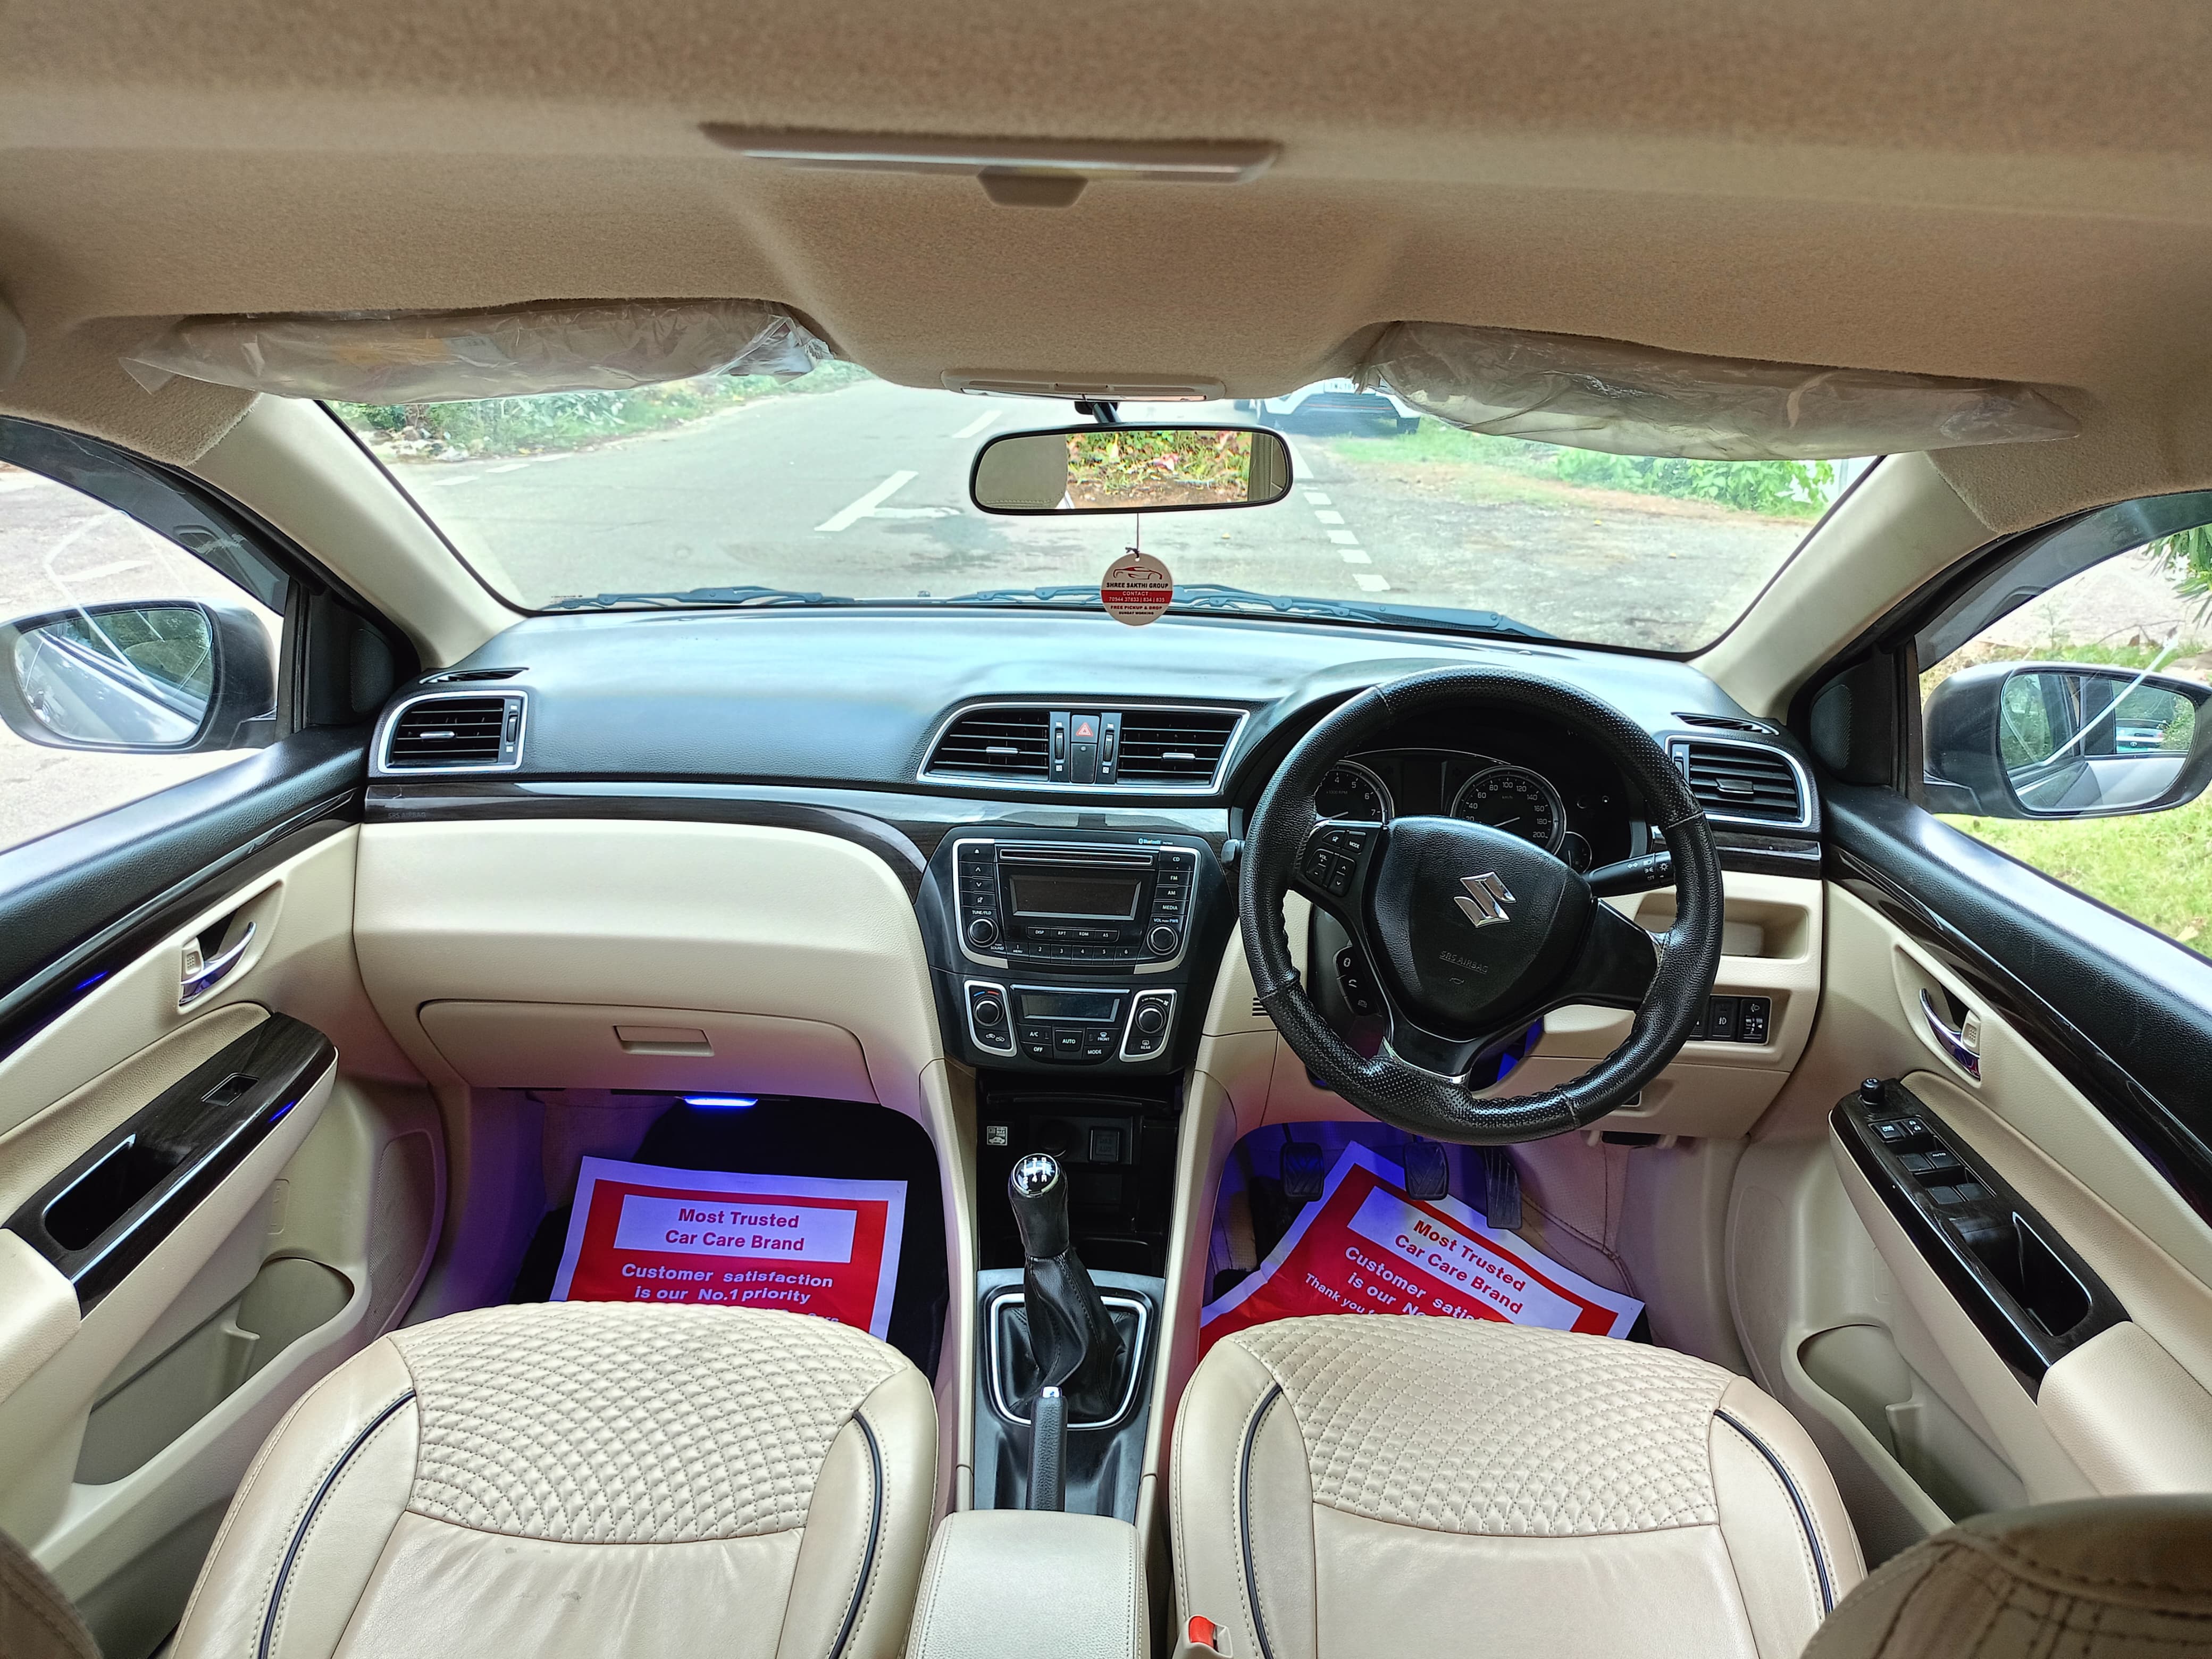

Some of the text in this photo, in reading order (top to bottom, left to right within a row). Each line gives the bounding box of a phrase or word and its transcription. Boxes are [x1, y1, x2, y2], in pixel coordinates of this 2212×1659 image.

[1457, 957, 1489, 973] AIRBAG
[678, 1208, 799, 1228] Most Trusted
[665, 1229, 805, 1251] Car Care Brand
[1413, 1220, 1527, 1292] Most Trusted
[621, 1263, 834, 1288] Customer satisfaction
[1345, 1246, 1427, 1298] Customer
[1395, 1234, 1523, 1314] Car Care Brand
[634, 1286, 811, 1304] is our No.1 priority
[1305, 1272, 1365, 1313] Thank you
[1347, 1272, 1364, 1288] is
[1367, 1286, 1396, 1305] our
